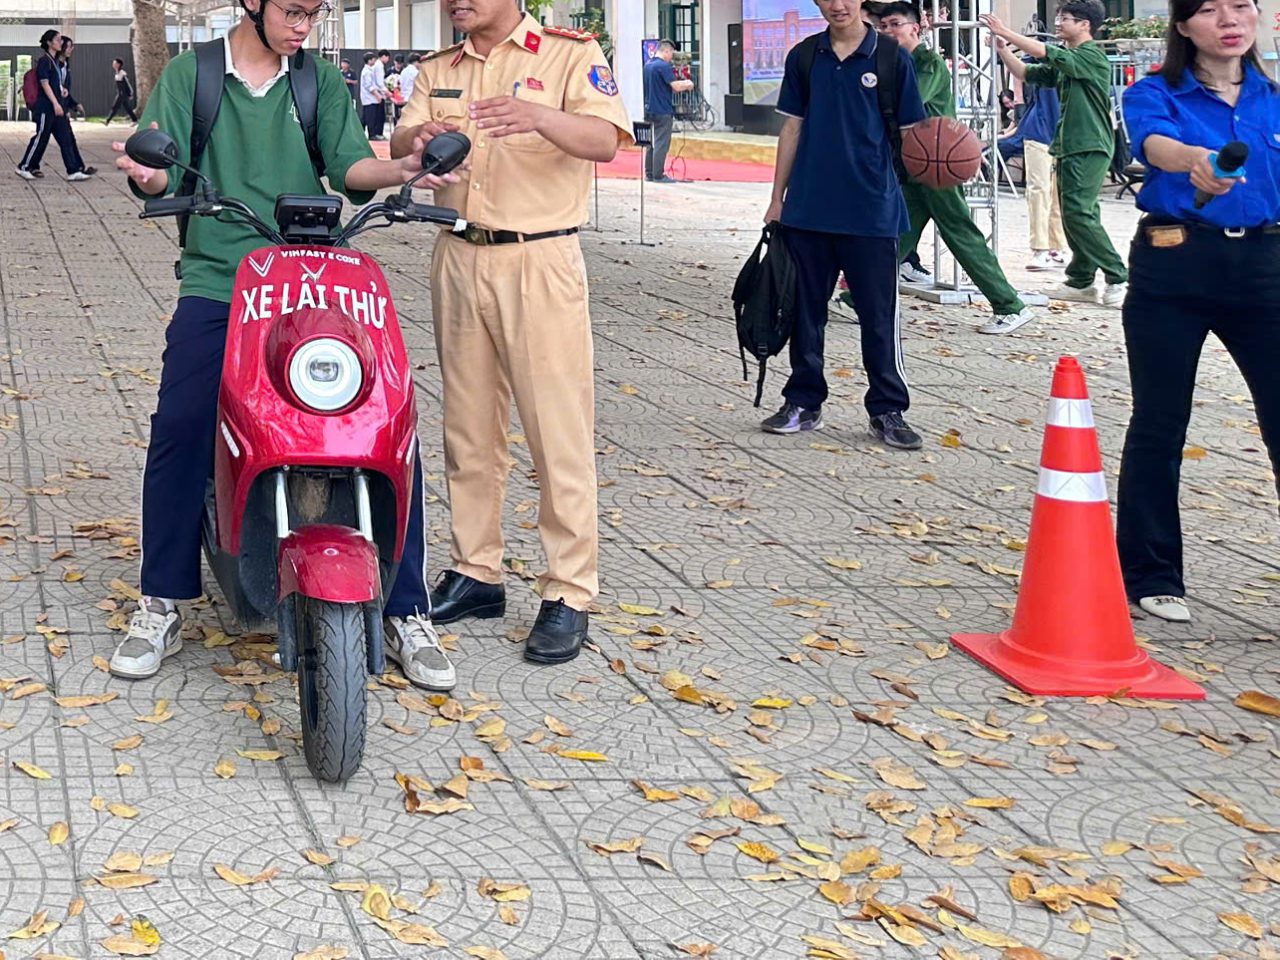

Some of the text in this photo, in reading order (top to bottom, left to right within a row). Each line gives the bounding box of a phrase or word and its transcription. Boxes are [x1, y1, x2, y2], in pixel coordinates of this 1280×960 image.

[280, 250, 326, 259] VINFAST
[241, 273, 388, 330] XE LÁI THỬ
